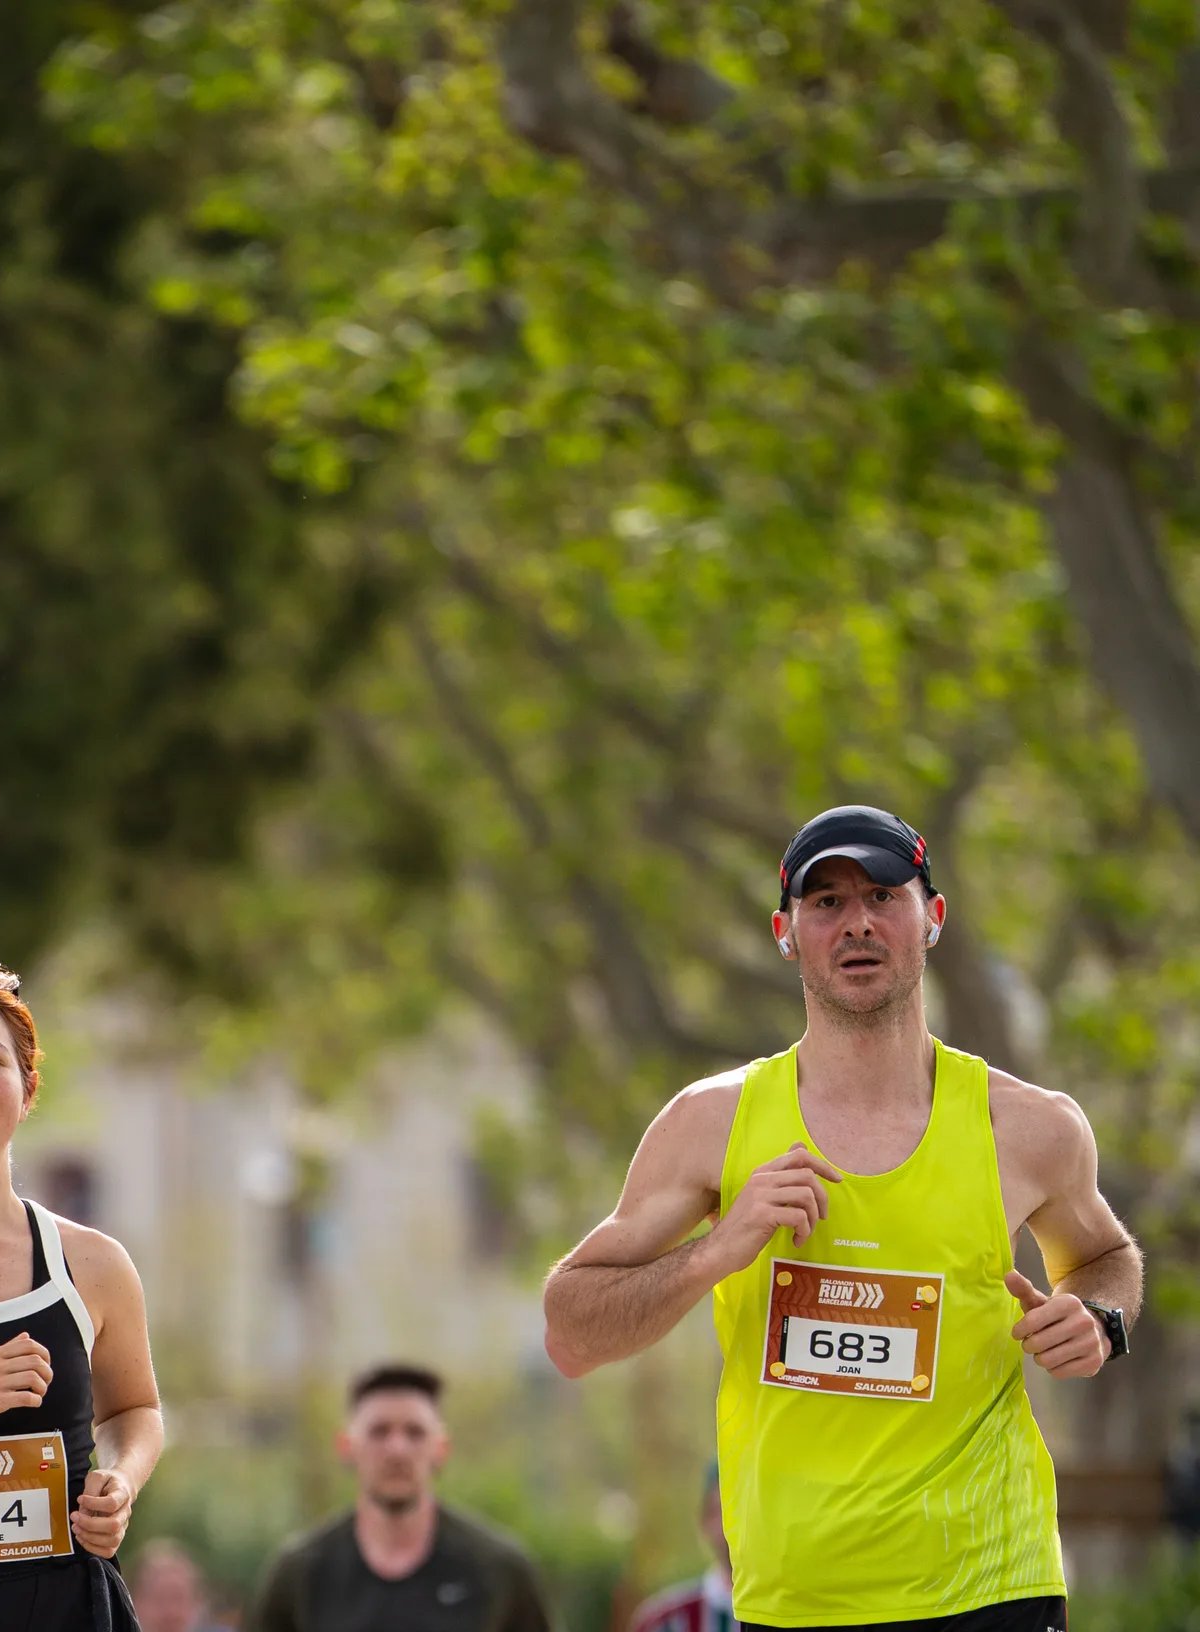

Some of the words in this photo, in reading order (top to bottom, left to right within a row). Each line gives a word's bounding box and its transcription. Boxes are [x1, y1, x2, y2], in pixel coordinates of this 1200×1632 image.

[833, 1239, 880, 1249] SALOMON
[819, 1278, 855, 1287] SALOMON
[818, 1284, 854, 1301] RUN
[817, 1297, 853, 1307] BARCELONA
[809, 1330, 891, 1364] 683
[836, 1365, 861, 1375] JOAN
[854, 1382, 912, 1395] SALOMON
[0, 1544, 54, 1557] SALOMON
